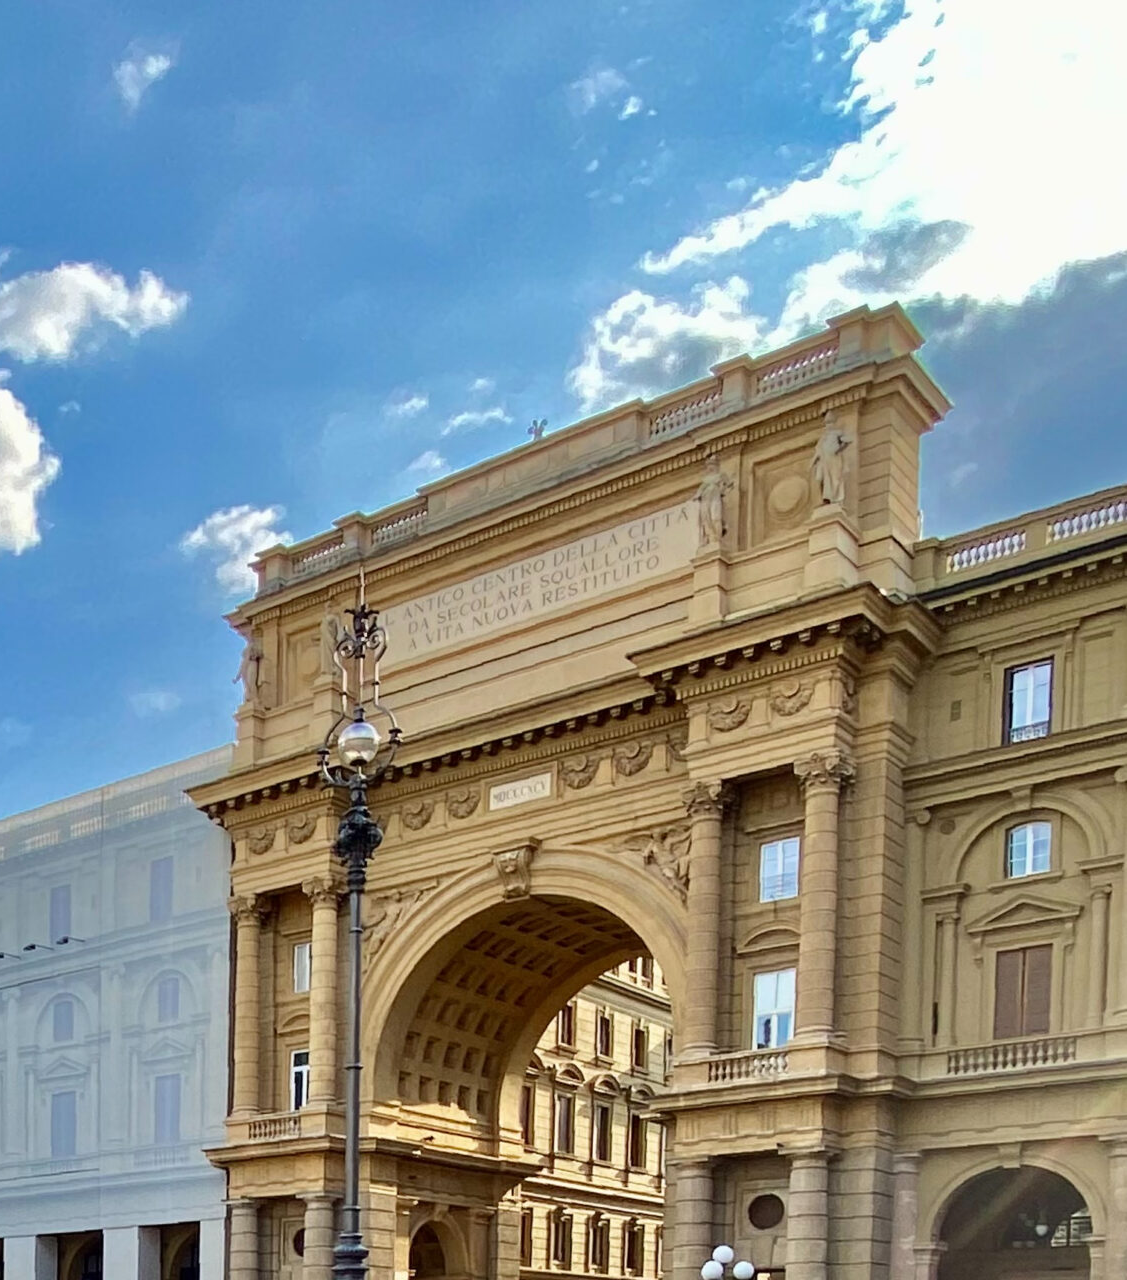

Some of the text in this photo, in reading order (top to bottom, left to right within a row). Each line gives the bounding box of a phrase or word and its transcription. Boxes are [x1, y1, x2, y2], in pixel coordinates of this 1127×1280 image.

[403, 587, 464, 619] ANTICO
[471, 559, 545, 595] CENTRO
[553, 532, 618, 567] DELLA
[408, 536, 660, 635] DA SECOLARE SQUALLORE
[408, 554, 660, 652] A VITA NUOVA RESTITUITO
